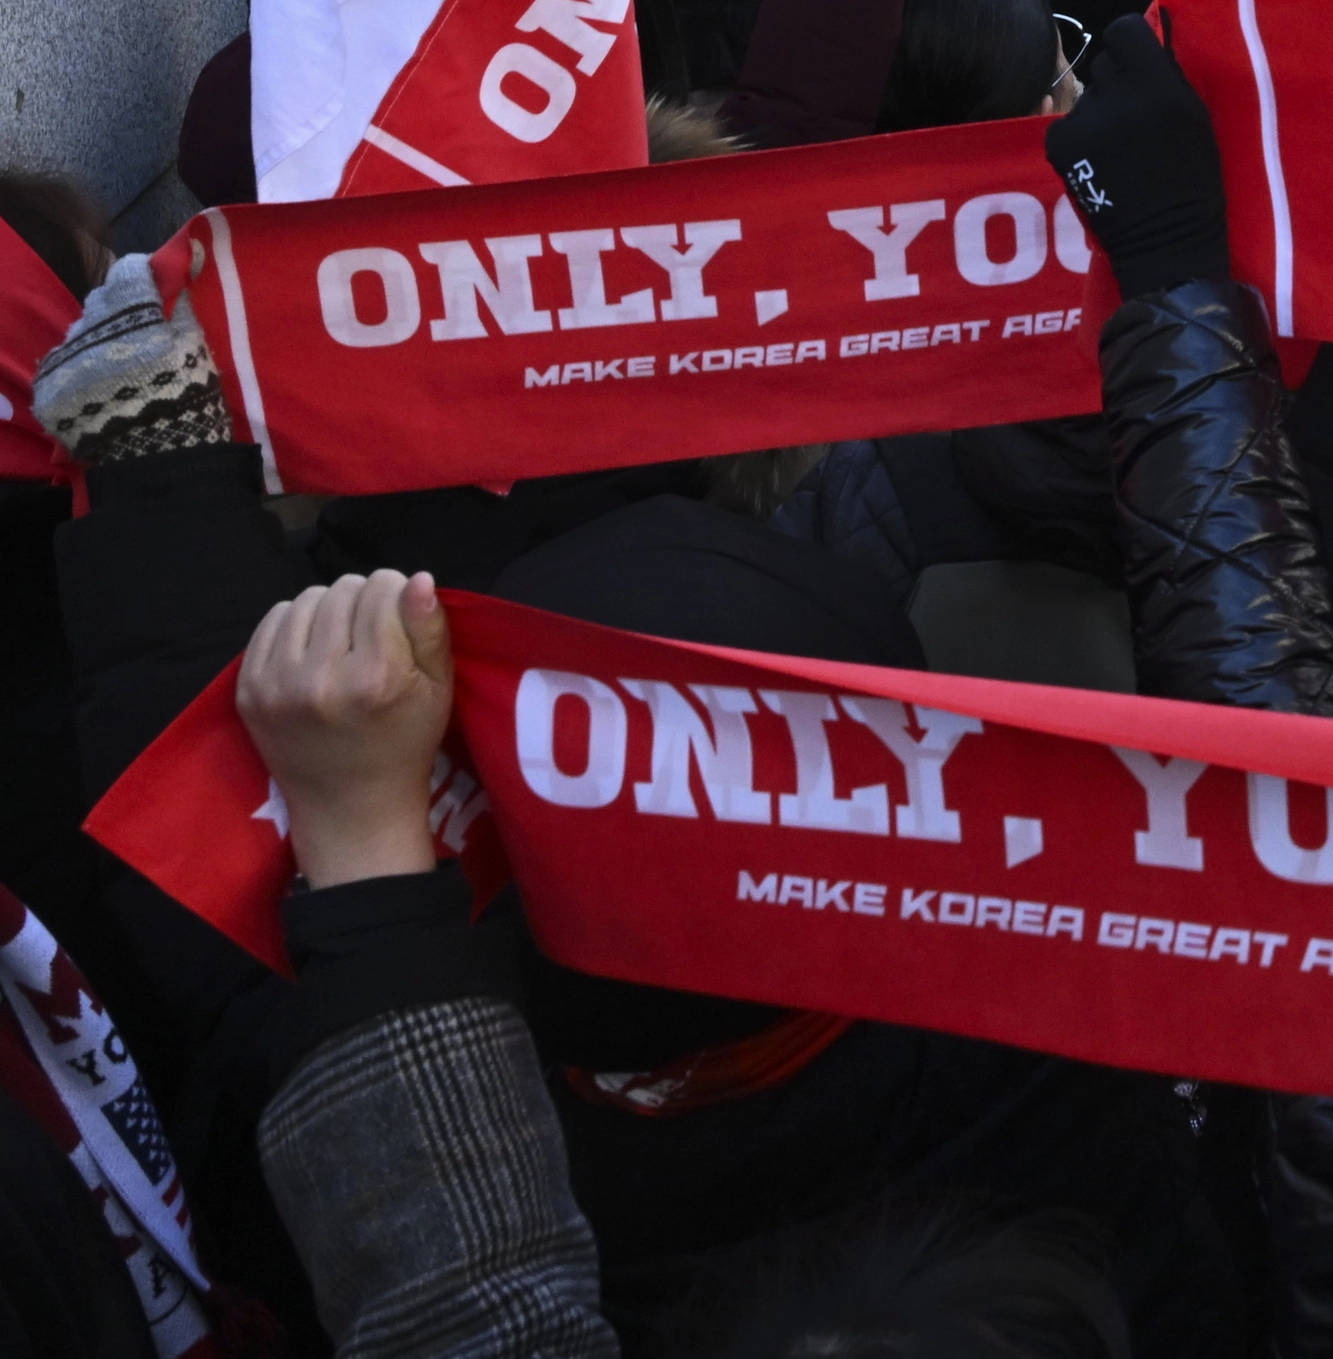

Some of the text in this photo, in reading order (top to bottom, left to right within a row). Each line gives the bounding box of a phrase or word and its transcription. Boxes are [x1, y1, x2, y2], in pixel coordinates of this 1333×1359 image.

[316, 219, 789, 349] ONLY,
[523, 352, 656, 390] MAKE
[668, 339, 828, 376] KOREA
[838, 317, 982, 359] GREAT
[515, 667, 1044, 870] ONLY,
[736, 869, 888, 917] MAKE
[899, 886, 1085, 942] KOREA
[1097, 910, 1289, 968] GREAT
